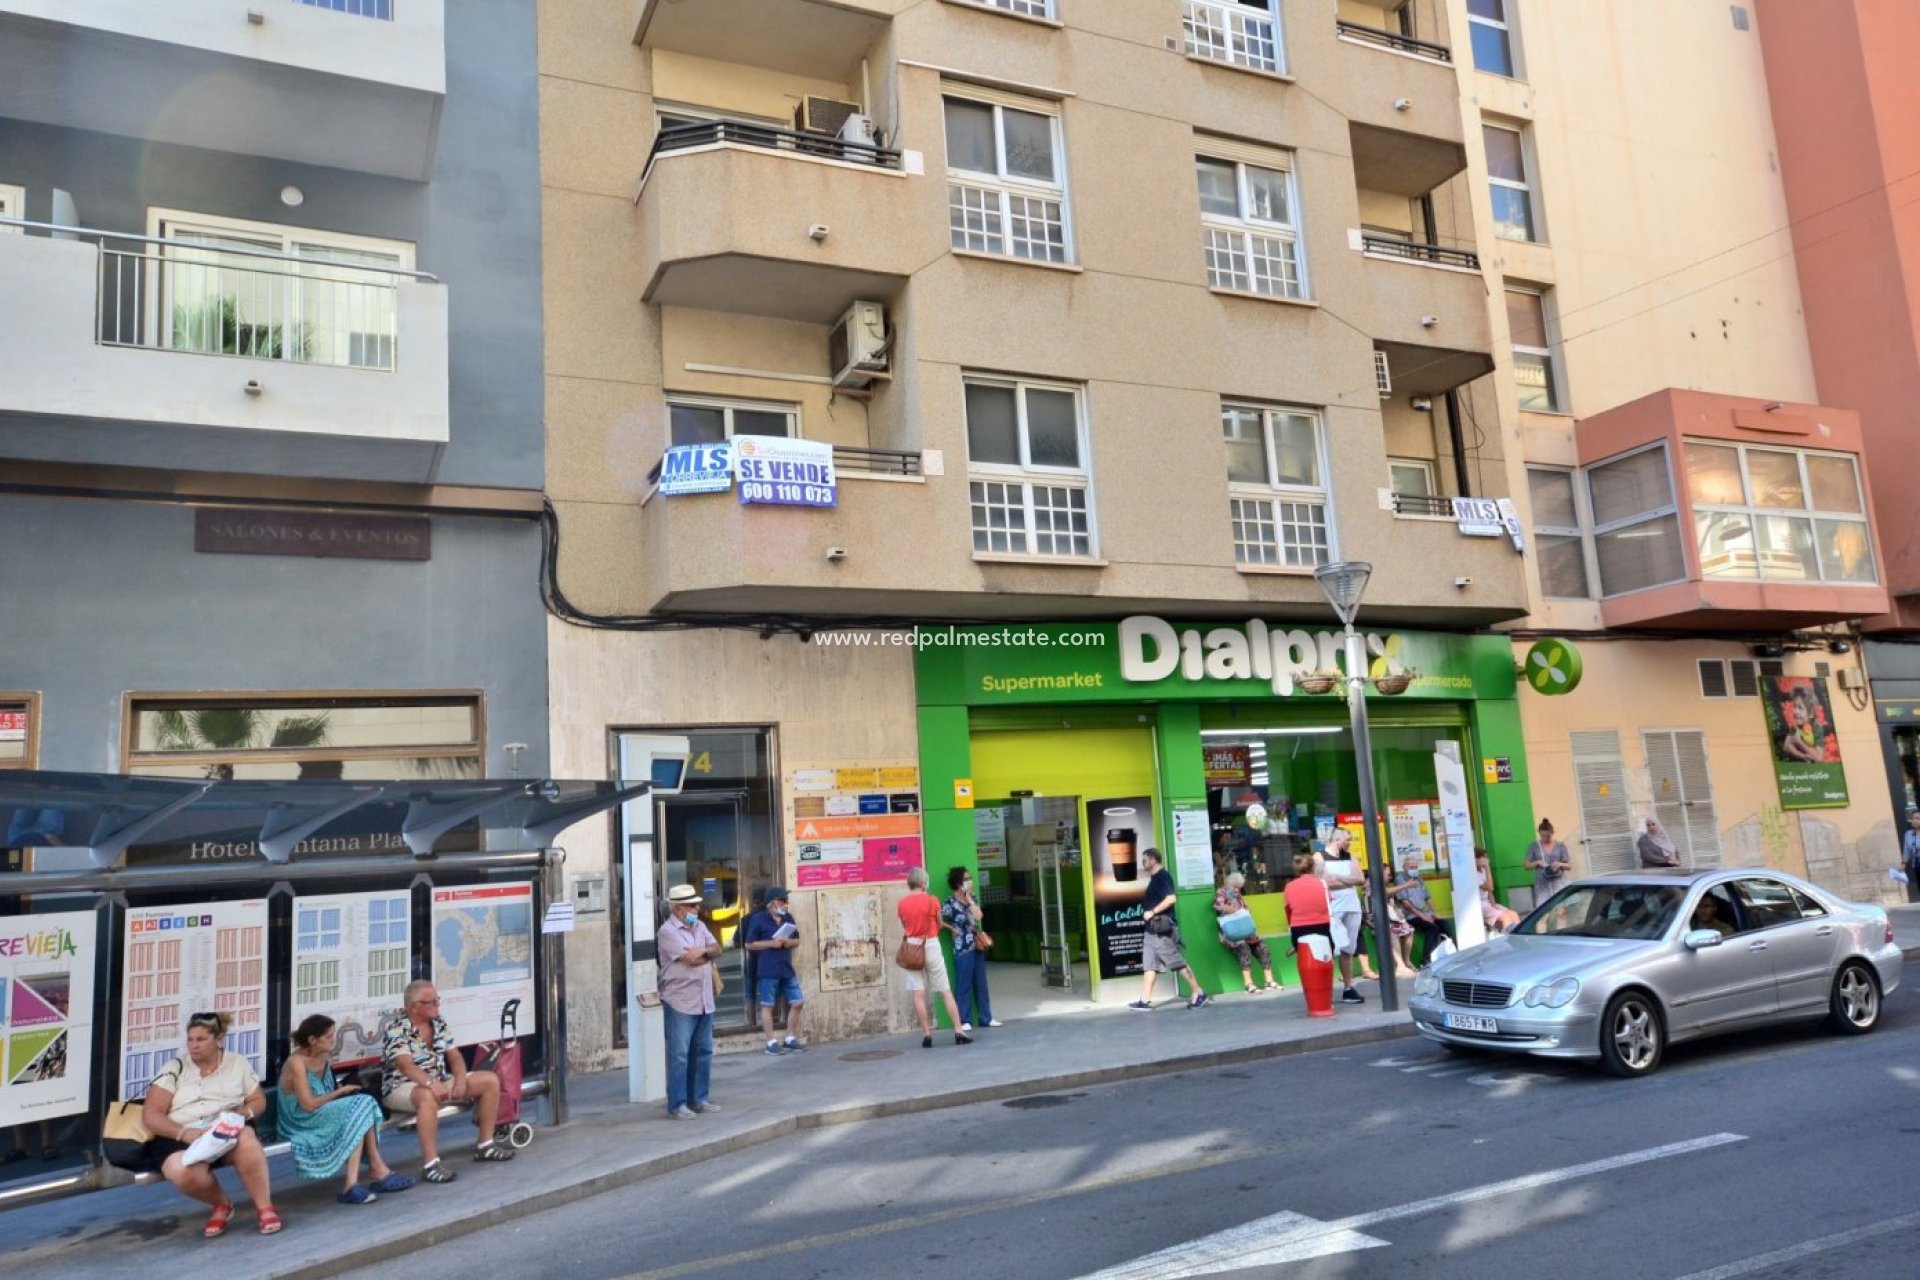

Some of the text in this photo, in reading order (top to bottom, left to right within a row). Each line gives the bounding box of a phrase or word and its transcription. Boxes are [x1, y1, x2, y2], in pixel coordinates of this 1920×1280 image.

[666, 449, 728, 474] MLS
[740, 459, 830, 484] SE VENDE
[743, 482, 773, 500] 600
[776, 484, 801, 501] 110
[1455, 502, 1496, 520] MLS
[209, 524, 420, 545] SALONES & EVENTOS
[982, 672, 1103, 693] Supermarket
[190, 832, 405, 860] Hotel ntana Pla
[1451, 1014, 1473, 1028] 1865
